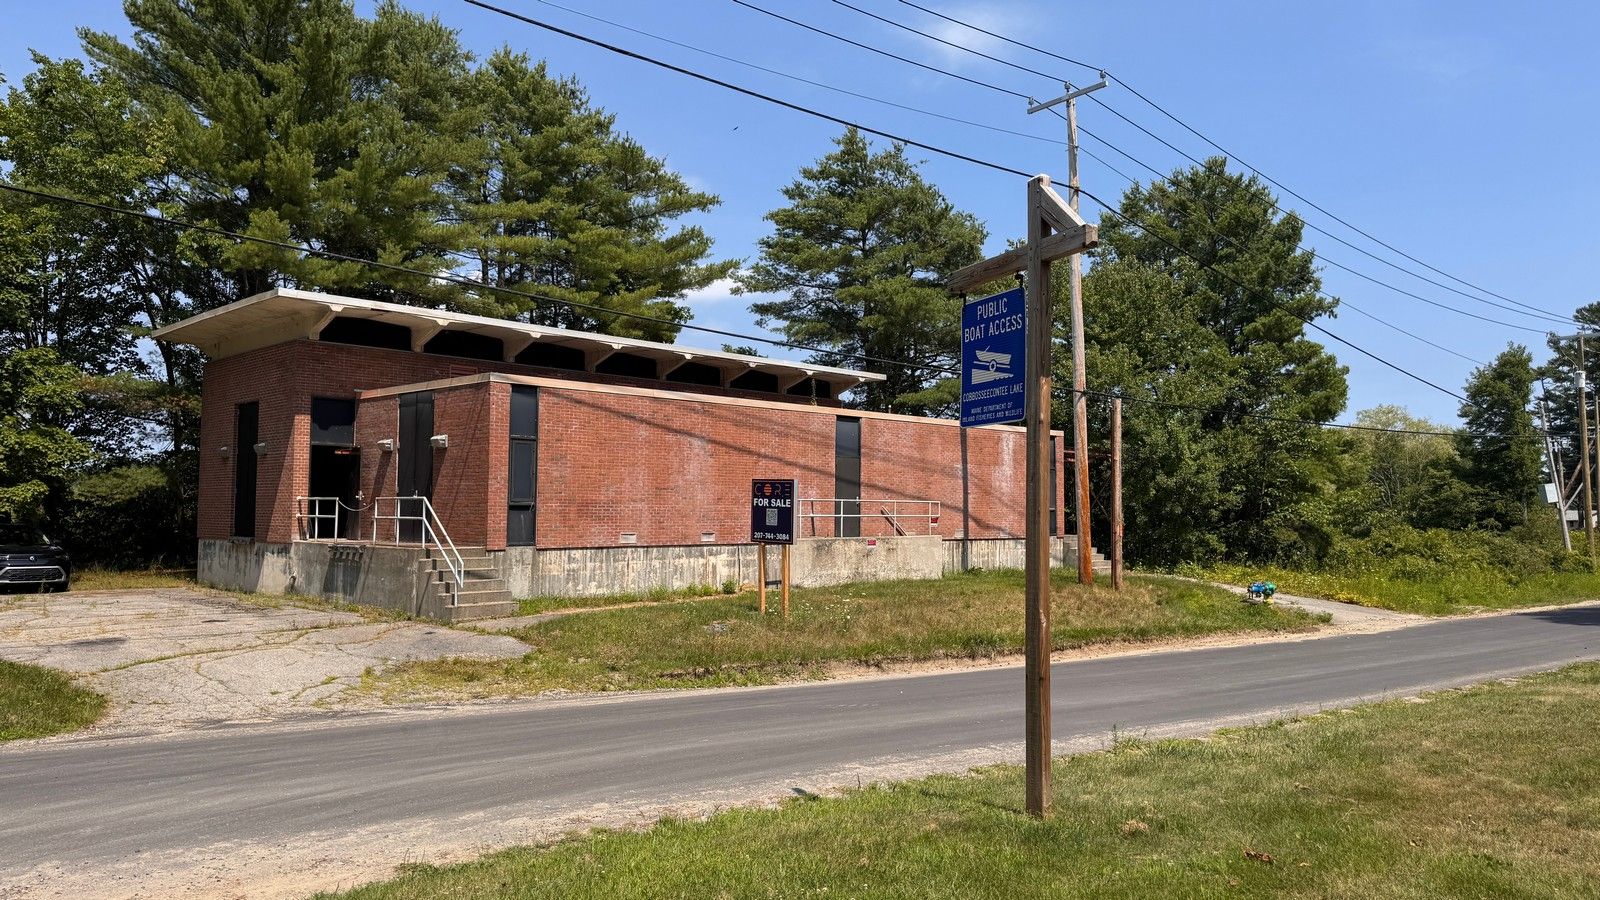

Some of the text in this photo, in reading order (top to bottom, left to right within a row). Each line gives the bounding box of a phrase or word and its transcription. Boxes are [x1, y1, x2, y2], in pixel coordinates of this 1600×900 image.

[977, 297, 1007, 320] PUBLIC
[964, 313, 1022, 342] BOAT ACCESS
[963, 382, 1023, 402] COBBOSSEECONTEE LAKE
[983, 403, 1006, 412] DEPARTMENT
[976, 412, 995, 420] FISHERIES
[1005, 408, 1022, 416] WILDLIFE
[755, 484, 790, 496] CORE
[753, 498, 791, 508] FOR SALE
